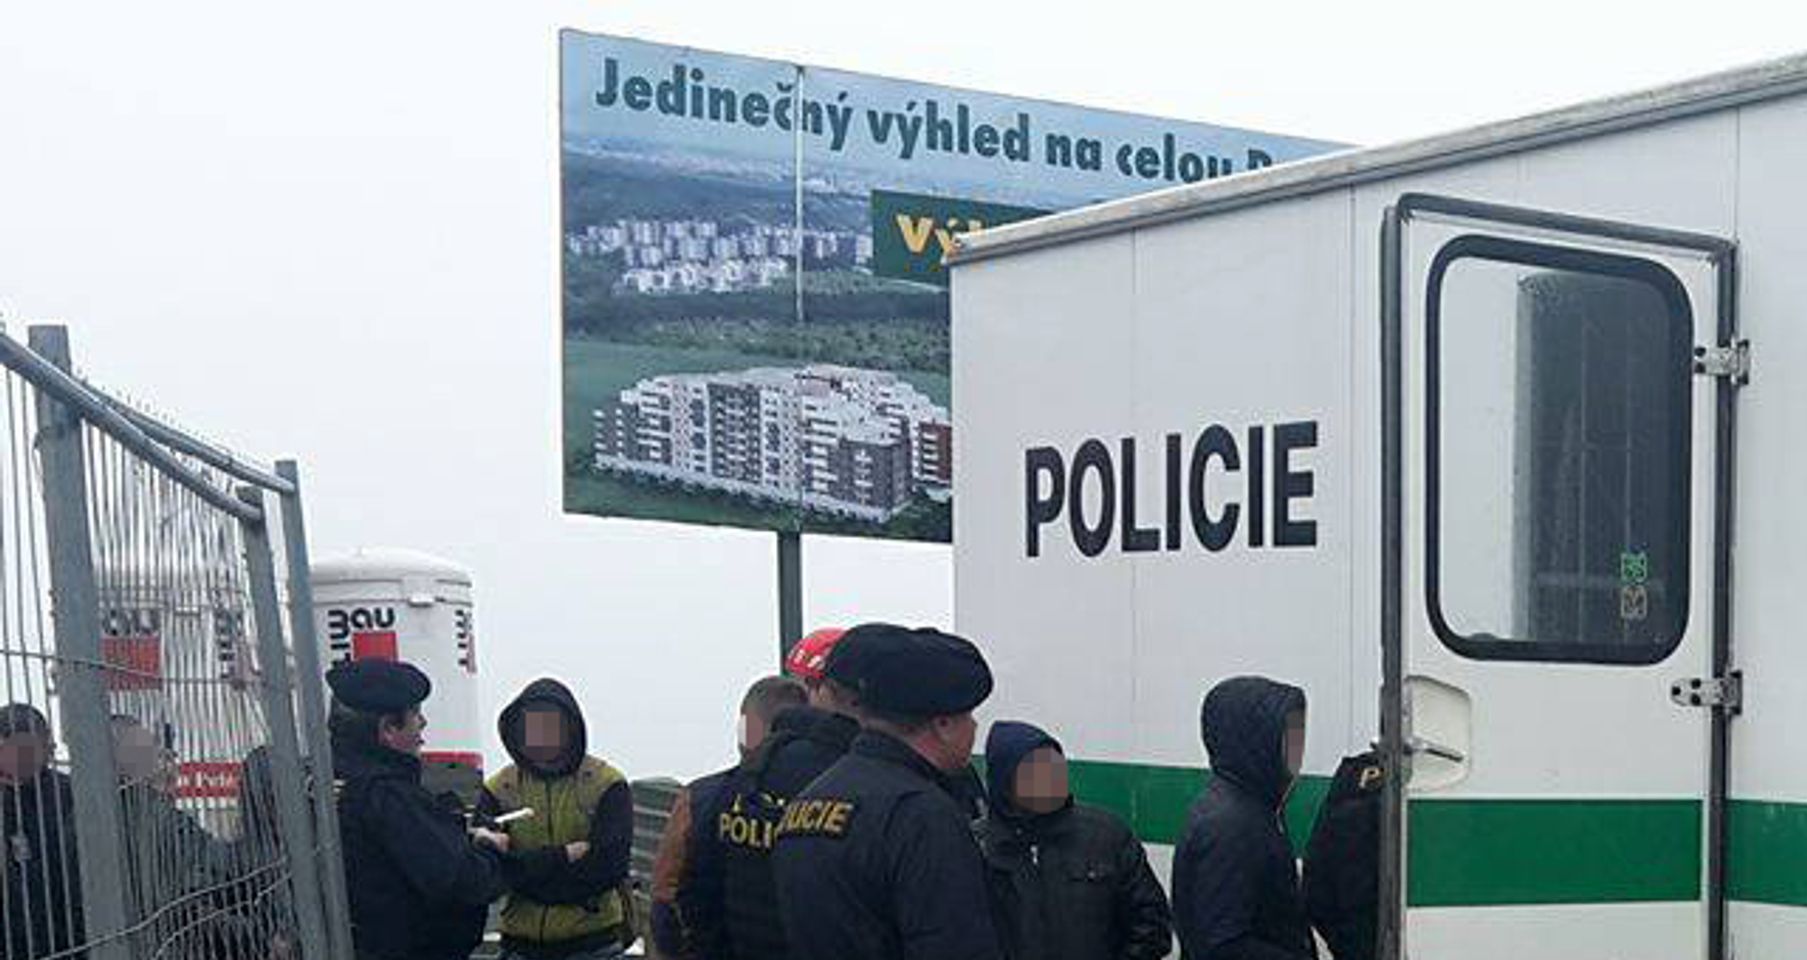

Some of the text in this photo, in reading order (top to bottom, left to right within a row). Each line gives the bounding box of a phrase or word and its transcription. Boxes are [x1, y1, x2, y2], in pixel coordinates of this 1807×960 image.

[596, 57, 1232, 183] Jedinečný výhled na celou
[1025, 421, 1318, 557] POLICIE
